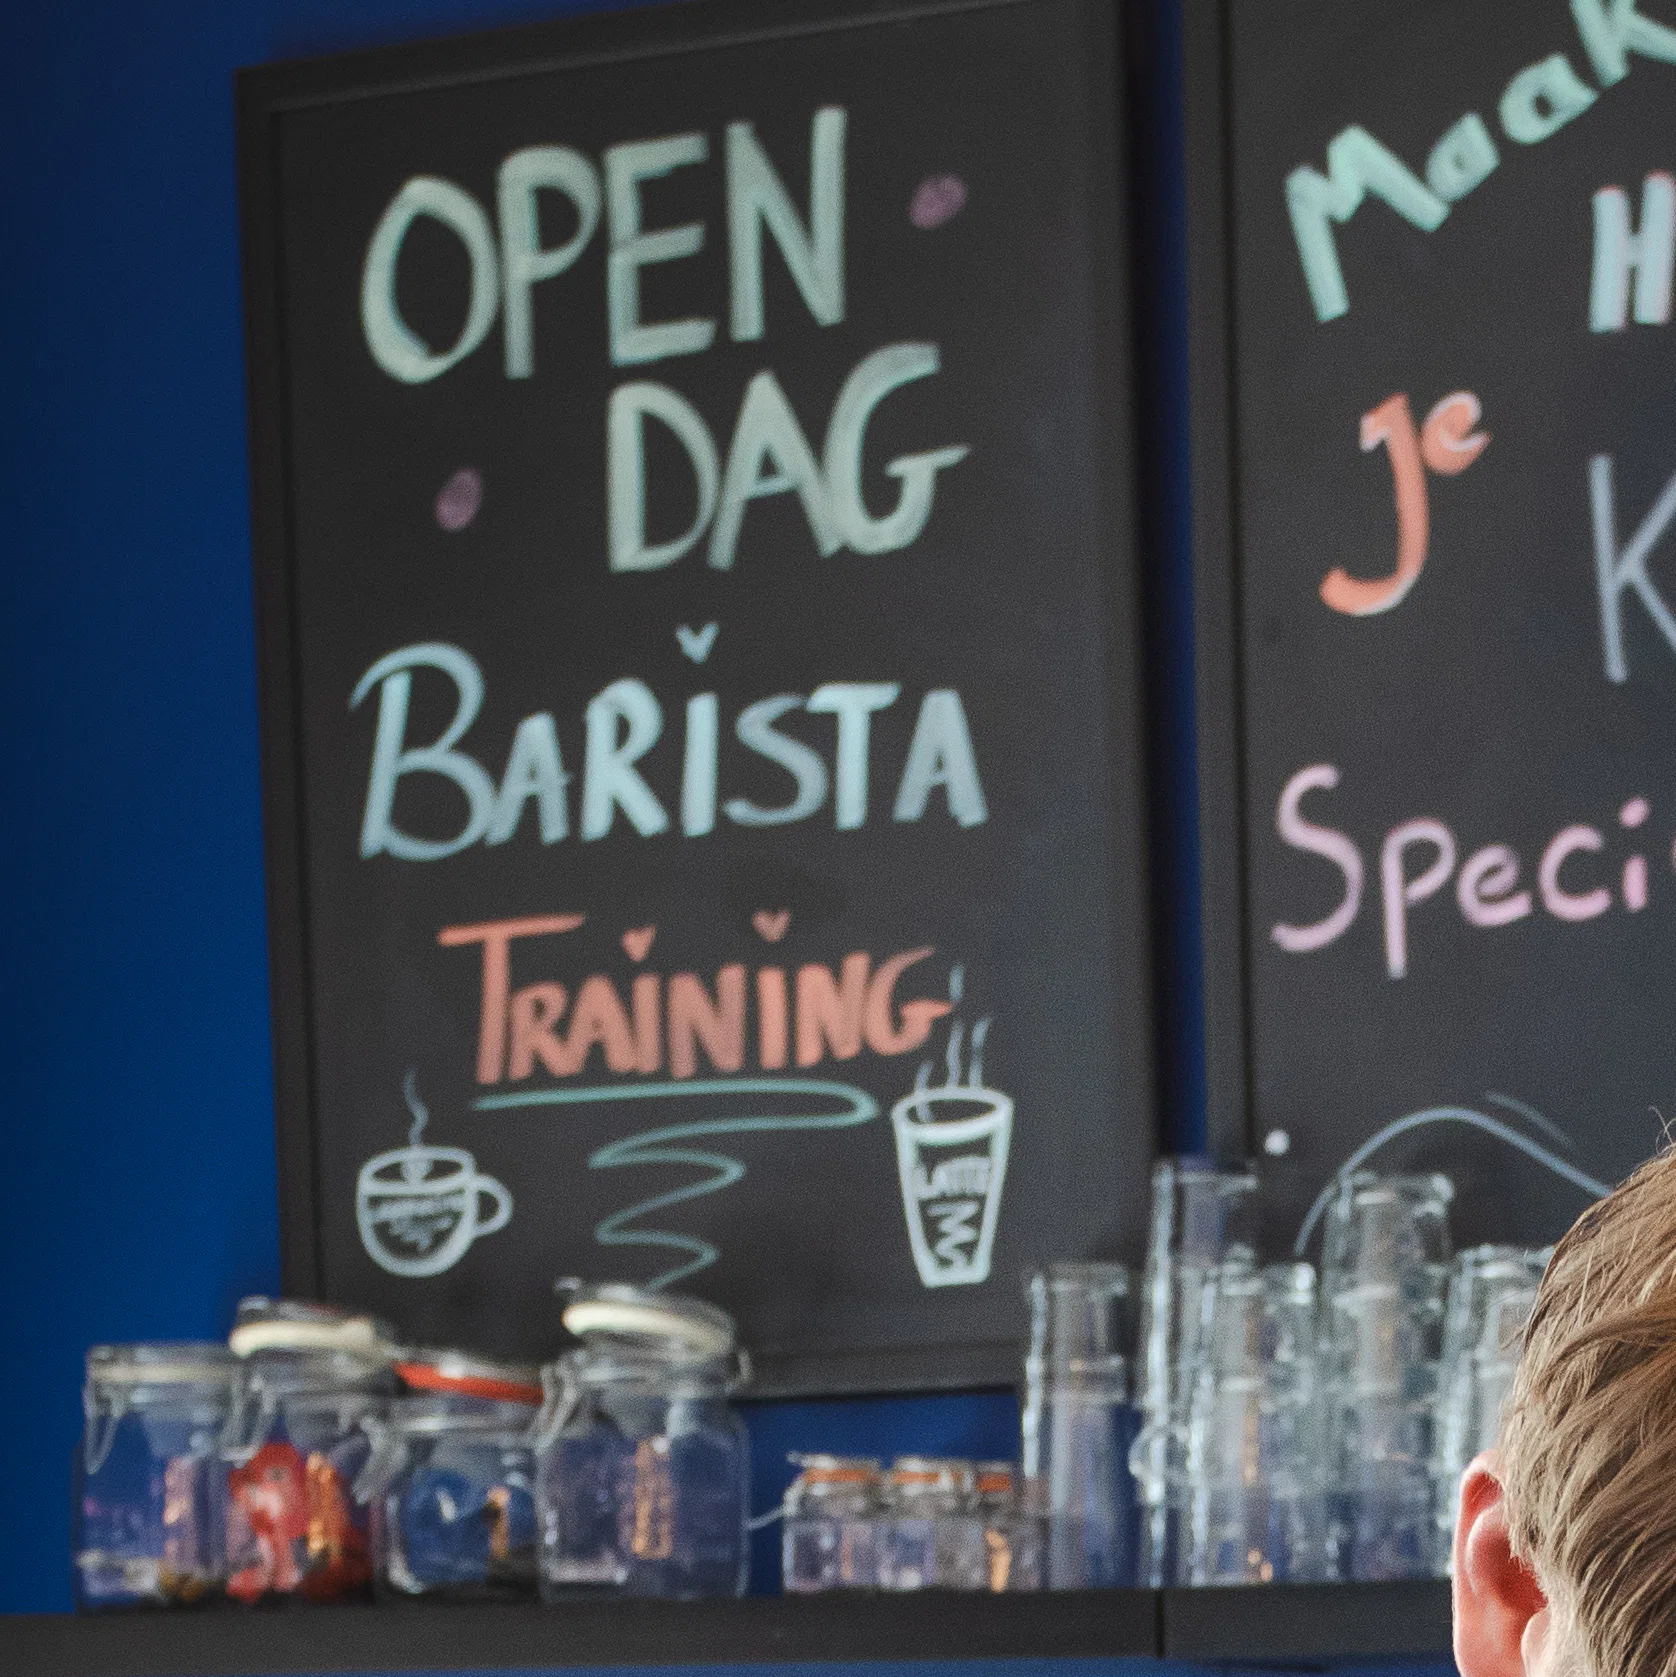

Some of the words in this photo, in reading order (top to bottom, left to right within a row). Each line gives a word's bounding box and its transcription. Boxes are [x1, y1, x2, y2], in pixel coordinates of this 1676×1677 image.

[360, 104, 848, 384] OPEN
[608, 341, 971, 573] DAG
[1321, 390, 1491, 615] Je
